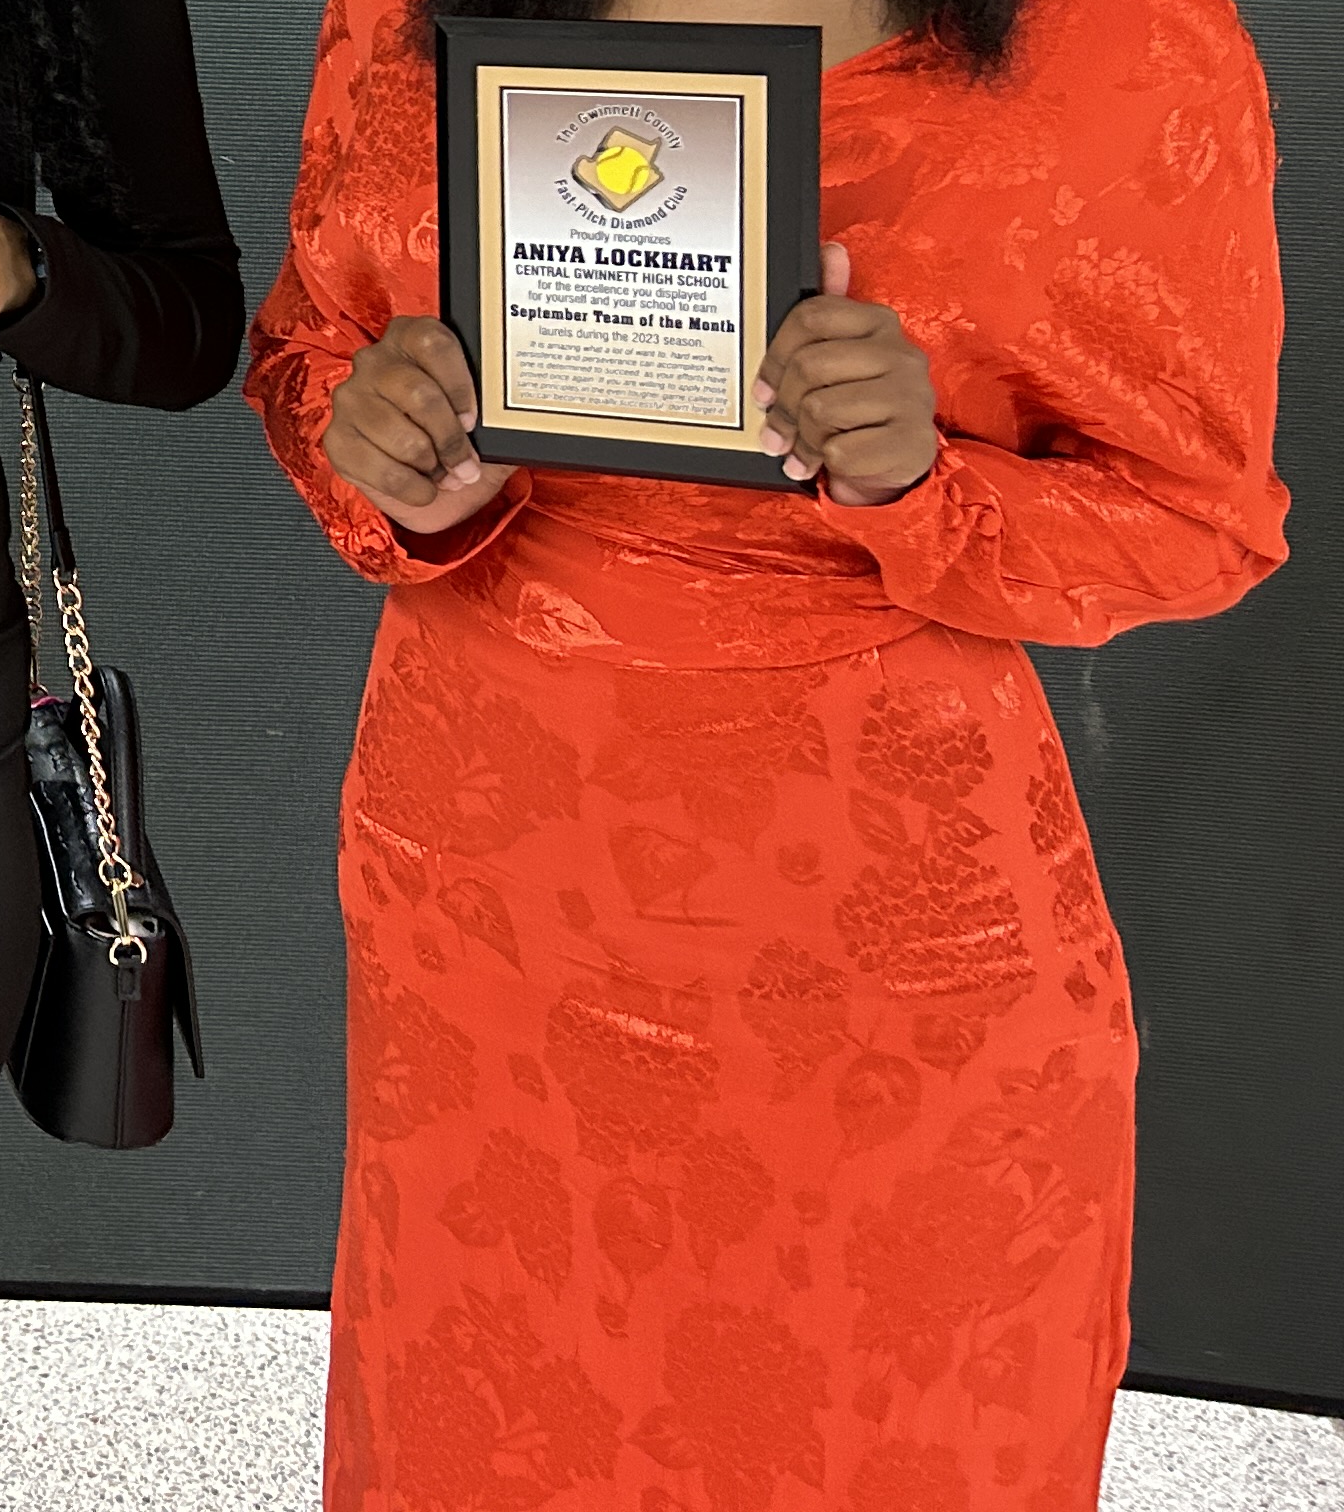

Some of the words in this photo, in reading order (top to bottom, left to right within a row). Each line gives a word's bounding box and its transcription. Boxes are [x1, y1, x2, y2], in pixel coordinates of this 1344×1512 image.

[556, 122, 578, 142] The
[577, 106, 639, 124] Gwinnett
[643, 111, 681, 149] County
[554, 179, 606, 226] Fast-Pitch
[611, 206, 667, 229] Diamond
[664, 186, 687, 209] Club
[570, 229, 609, 242] Proudly
[613, 232, 670, 246] recognizes
[513, 242, 585, 263] ANIYA
[594, 247, 731, 273] LOCKHART
[515, 264, 569, 278] CENTRAL
[574, 267, 637, 282] GWINNETT
[642, 272, 672, 285] HIGH
[677, 274, 728, 288] SCHOOL
[528, 290, 542, 300] for
[545, 291, 587, 306] yourself
[590, 295, 609, 305] and
[613, 298, 636, 309] your
[640, 298, 675, 310] school
[679, 301, 689, 311] to
[693, 304, 717, 313] earn
[538, 280, 551, 290] for
[555, 281, 571, 291] the
[574, 282, 628, 295] excellence
[632, 288, 651, 299] you
[655, 288, 706, 302] displayed
[510, 303, 587, 325] September
[593, 310, 633, 325] Team
[639, 313, 654, 327] of
[659, 315, 682, 329] the
[688, 317, 734, 333] Month
[539, 325, 572, 337] laurels
[576, 328, 608, 342] during
[611, 331, 627, 341] the
[631, 332, 659, 344] 2023
